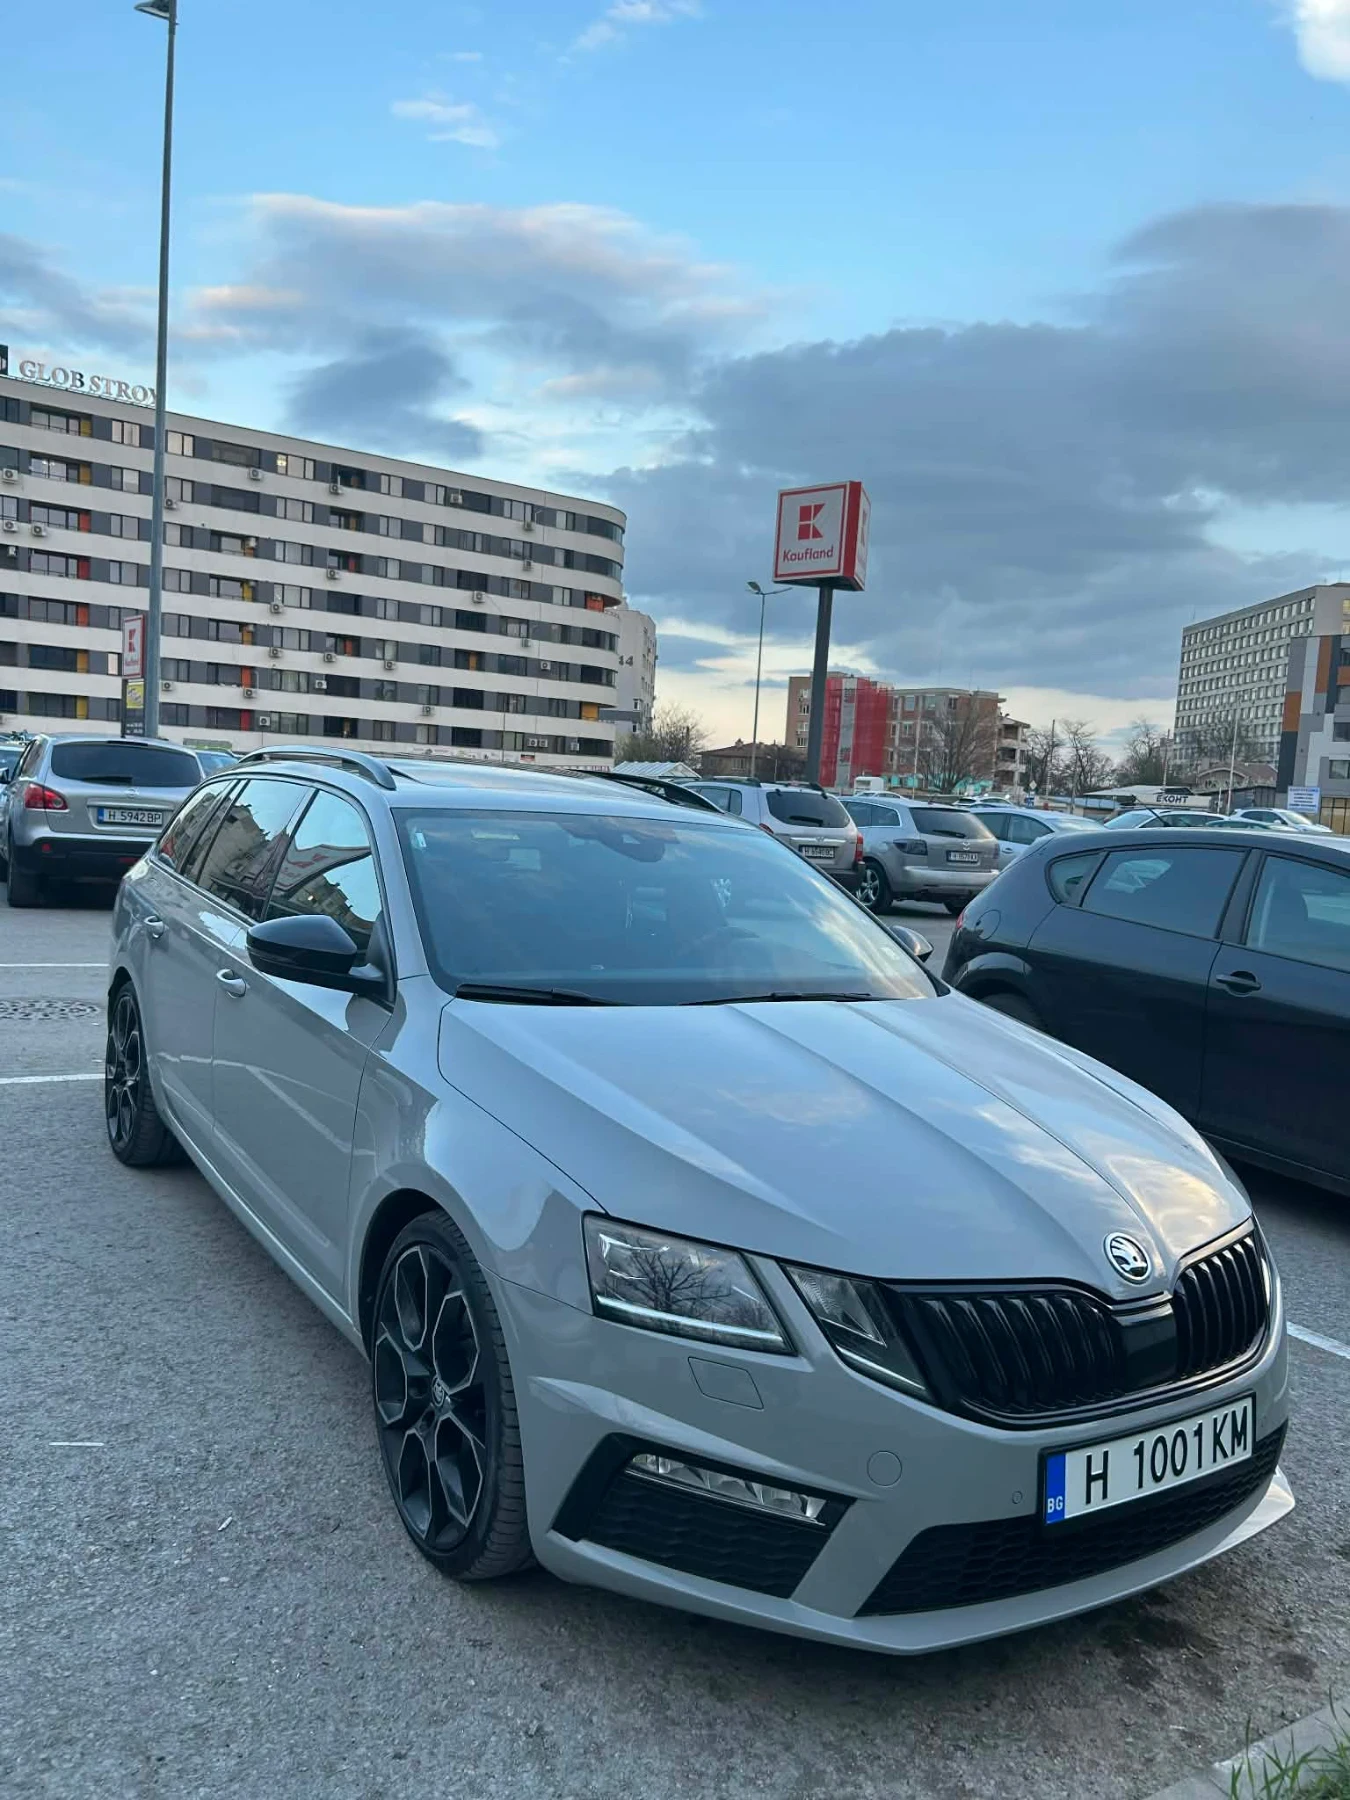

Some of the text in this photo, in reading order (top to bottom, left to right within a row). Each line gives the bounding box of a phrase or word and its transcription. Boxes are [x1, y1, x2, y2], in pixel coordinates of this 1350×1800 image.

[19, 360, 85, 388] GLOB
[783, 545, 834, 563] Kaufland
[1085, 1449, 1109, 1505] H
[1047, 1496, 1064, 1514] BG
